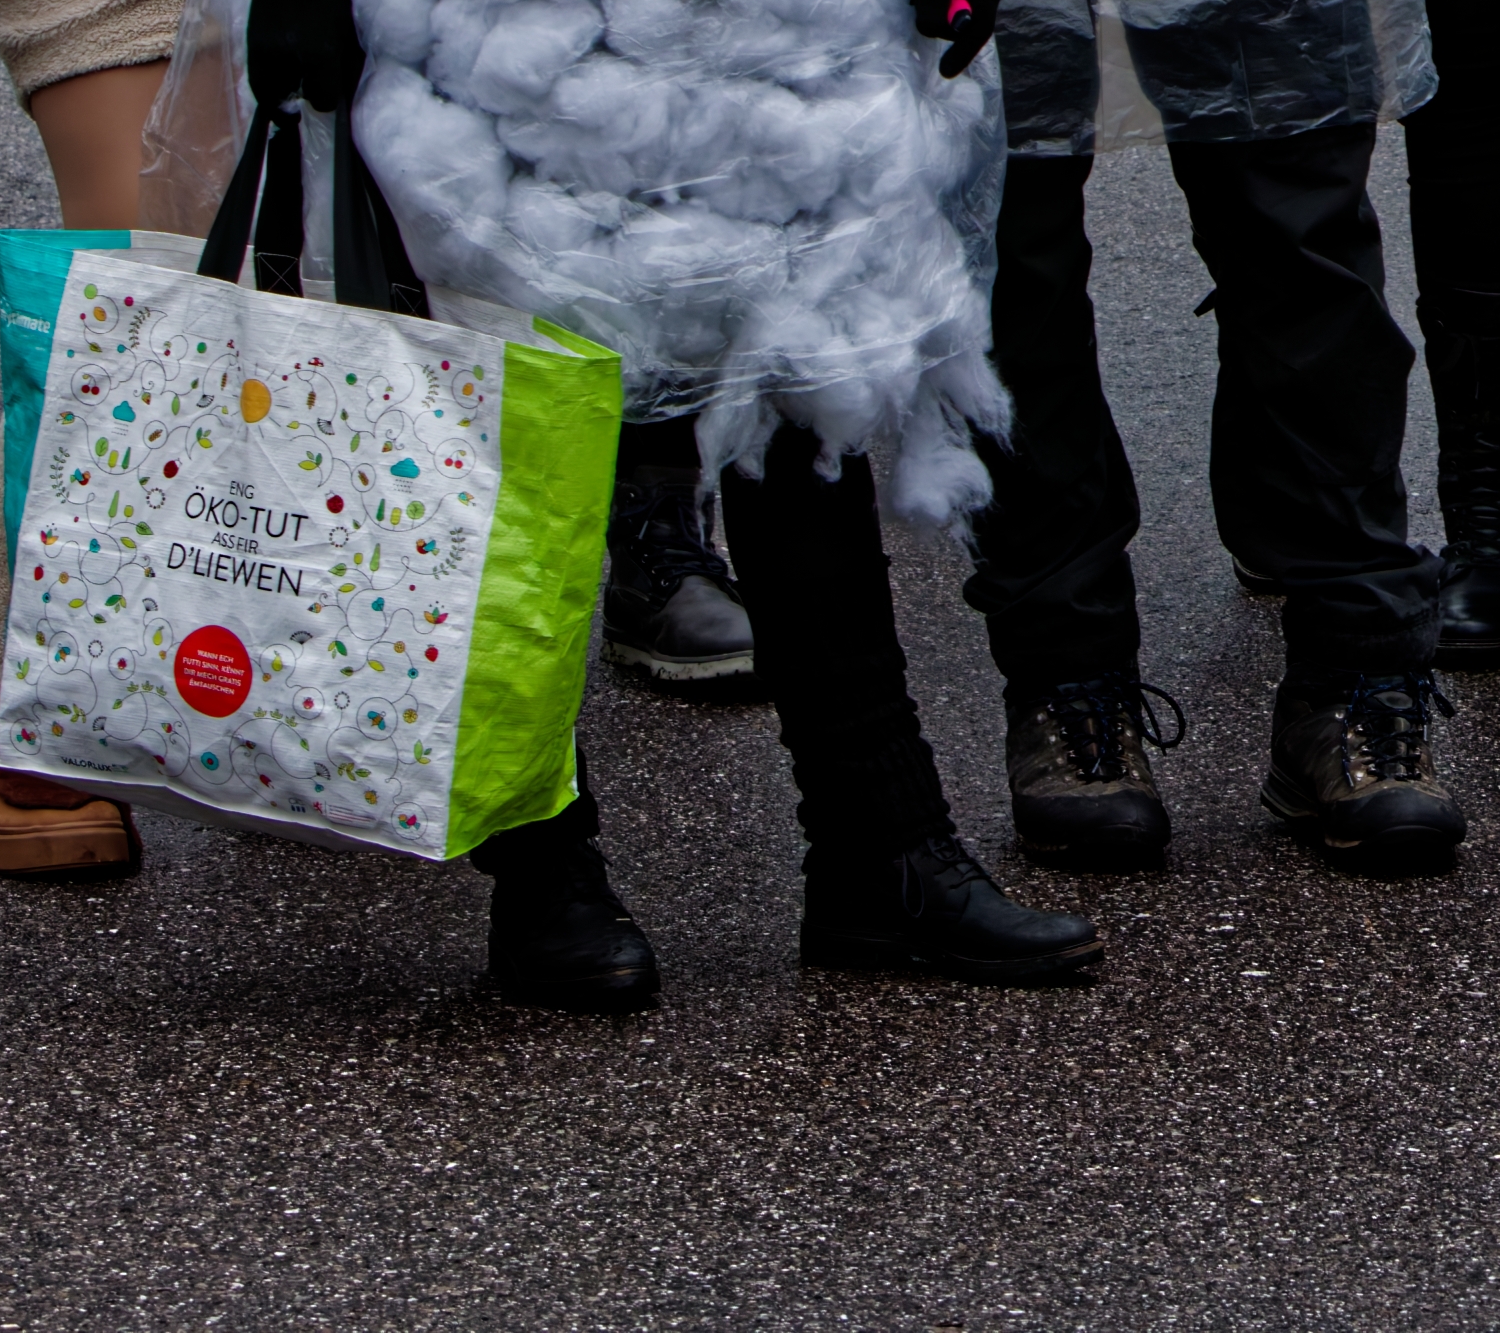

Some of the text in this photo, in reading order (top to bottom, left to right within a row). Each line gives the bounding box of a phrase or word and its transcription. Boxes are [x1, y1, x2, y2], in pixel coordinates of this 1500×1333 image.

[229, 480, 255, 500] ENG
[185, 485, 309, 541] ÖKO-TUT
[211, 531, 259, 555] ASS FIR
[197, 649, 235, 664] WANN ECH
[183, 667, 242, 687] DIR MECH GRATIS
[61, 756, 113, 773] VALORLUX
